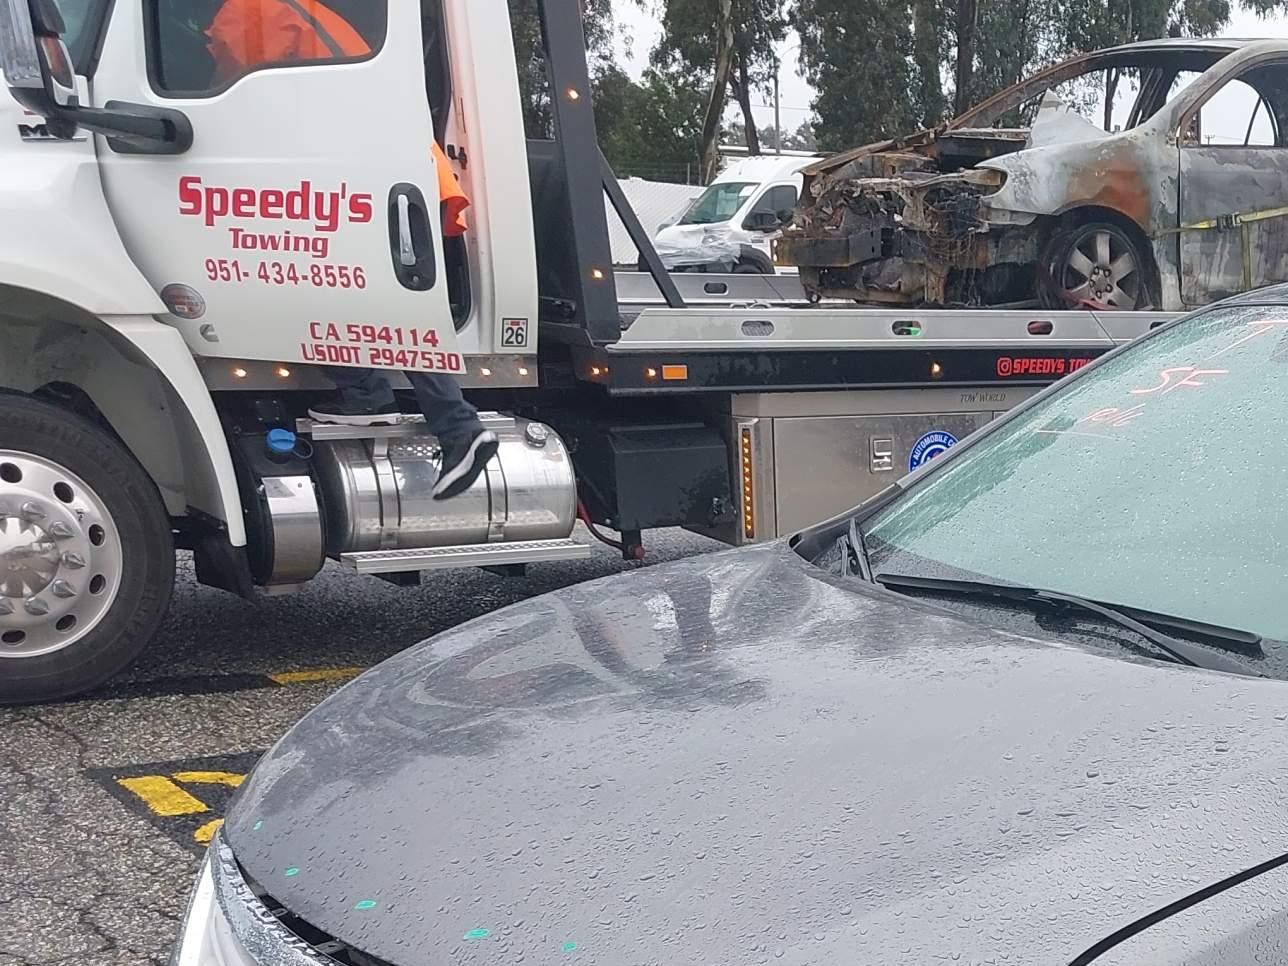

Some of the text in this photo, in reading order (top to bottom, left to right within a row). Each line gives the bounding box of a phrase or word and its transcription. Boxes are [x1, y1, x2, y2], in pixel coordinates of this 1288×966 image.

[179, 176, 373, 233] Speedy's
[229, 228, 329, 258] Towing
[205, 258, 366, 290] 951- 434-8556
[309, 322, 439, 348] CA 594114
[504, 327, 525, 345] 26
[301, 343, 461, 372] USDOT 2947530
[912, 434, 949, 461] AUTOMOBILE
